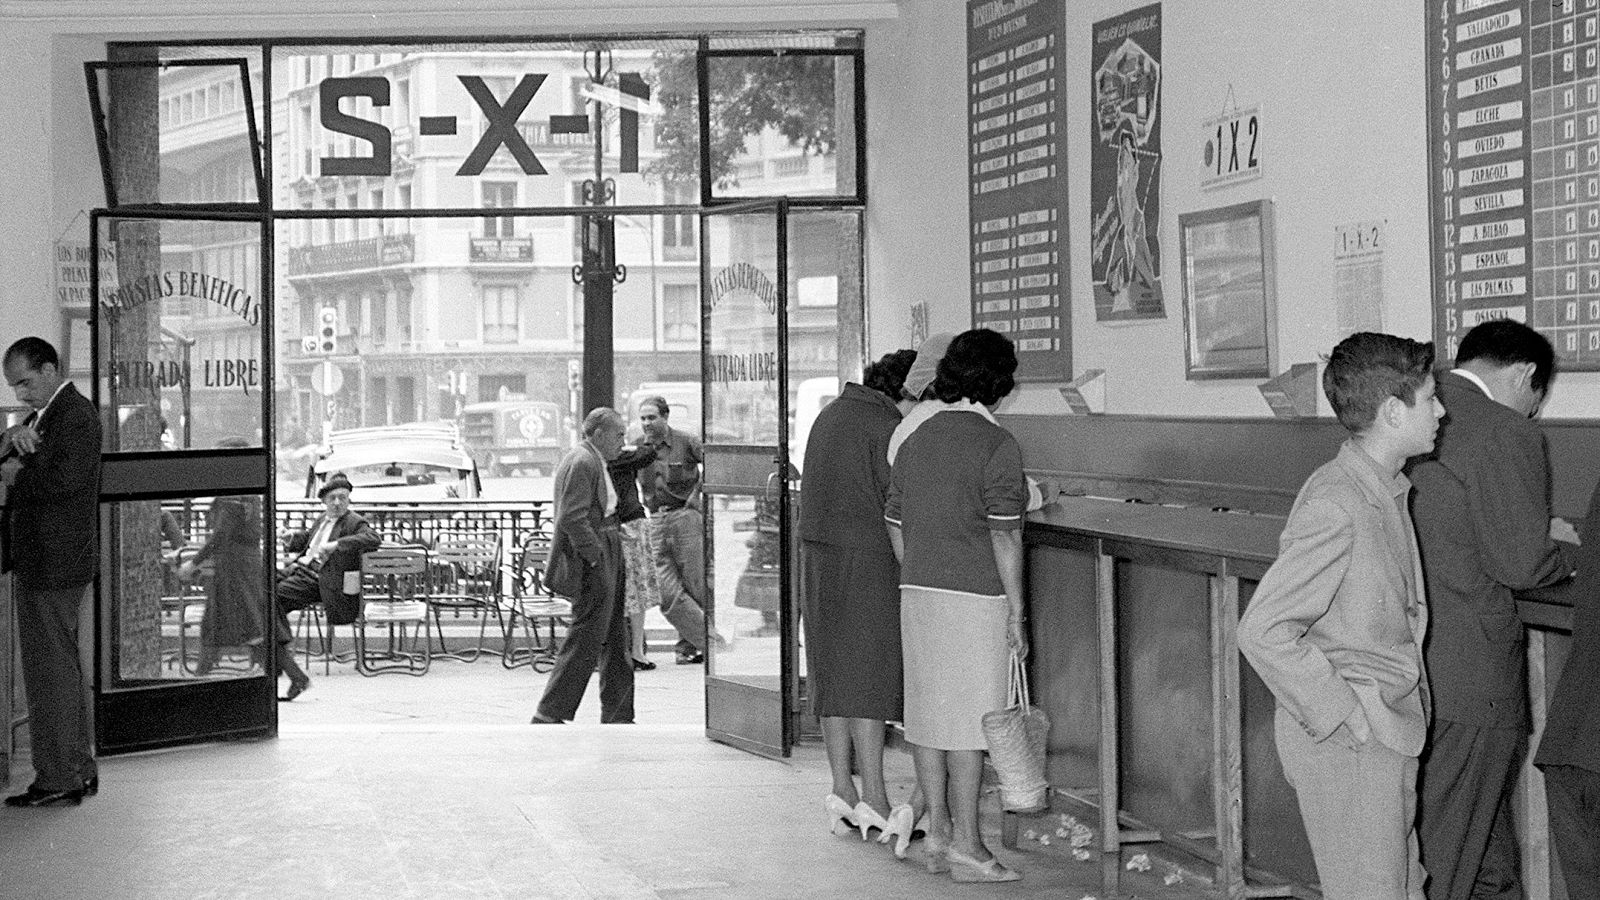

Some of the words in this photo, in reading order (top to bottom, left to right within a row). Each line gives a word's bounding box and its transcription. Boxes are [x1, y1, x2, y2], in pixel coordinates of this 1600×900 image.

[1442, 28, 1450, 53] 5
[1466, 14, 1510, 37] VALLADOLID
[1442, 56, 1450, 79] 6
[1470, 44, 1505, 65] GRANADA
[1442, 83, 1450, 108] 7
[1475, 73, 1498, 92] BETIS
[1442, 111, 1451, 136] 8
[1476, 106, 1500, 123] ELCHE
[1443, 140, 1451, 164] 9
[1475, 135, 1505, 153] OVIEDO
[1442, 167, 1454, 192] 10
[1471, 164, 1509, 184] ZARAGOZA
[1444, 196, 1454, 222] 11
[1475, 193, 1505, 211] SEVILLA
[1444, 224, 1455, 249] 12
[1482, 223, 1509, 238] BILBAO
[1445, 252, 1456, 276] 13
[179, 271, 261, 326] BENEFICAS
[1445, 280, 1457, 304] 14
[1471, 282, 1483, 297] LAS
[1485, 280, 1514, 295] PALMAS
[1446, 308, 1458, 332] 15
[1447, 335, 1459, 360] 16
[204, 359, 258, 396] LIBRE
[749, 352, 776, 390] LIBRE
